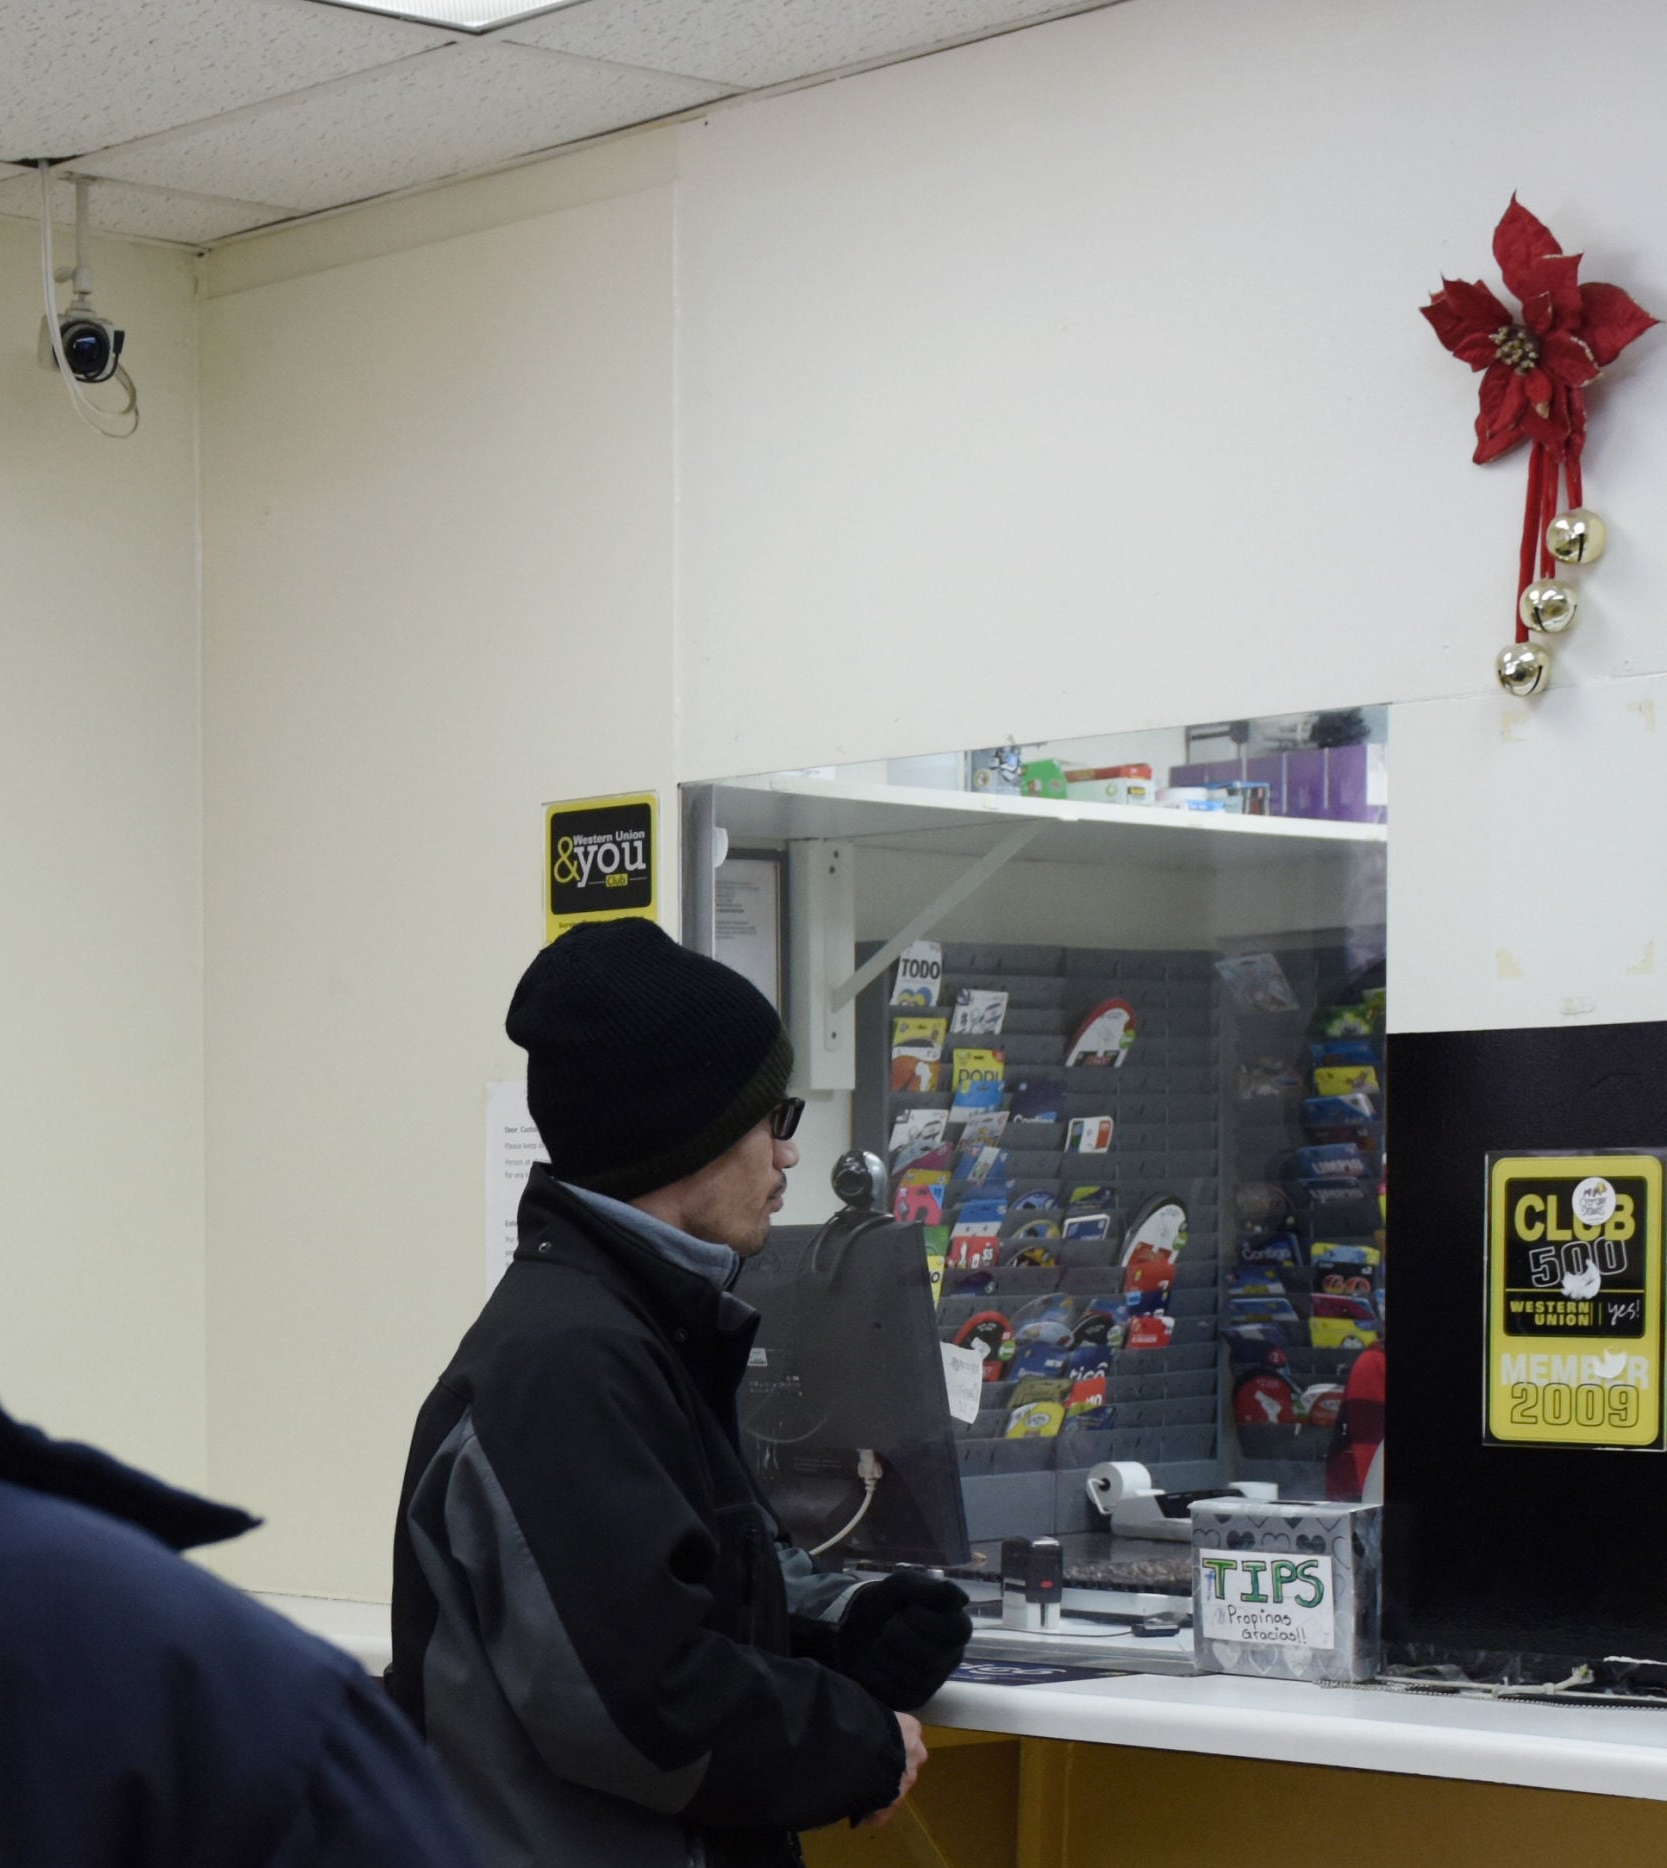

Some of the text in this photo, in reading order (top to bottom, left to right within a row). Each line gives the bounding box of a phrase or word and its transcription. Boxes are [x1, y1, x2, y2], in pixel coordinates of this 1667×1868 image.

[573, 829, 645, 846] Western Union
[901, 958, 940, 979] TODO
[1529, 1236, 1628, 1288] 500
[1510, 1300, 1590, 1313] WESTERN
[1534, 1313, 1590, 1327] UNION
[1510, 1381, 1640, 1428] 2009
[1202, 1557, 1325, 1609] TIPS
[1228, 1609, 1292, 1627] Propinas
